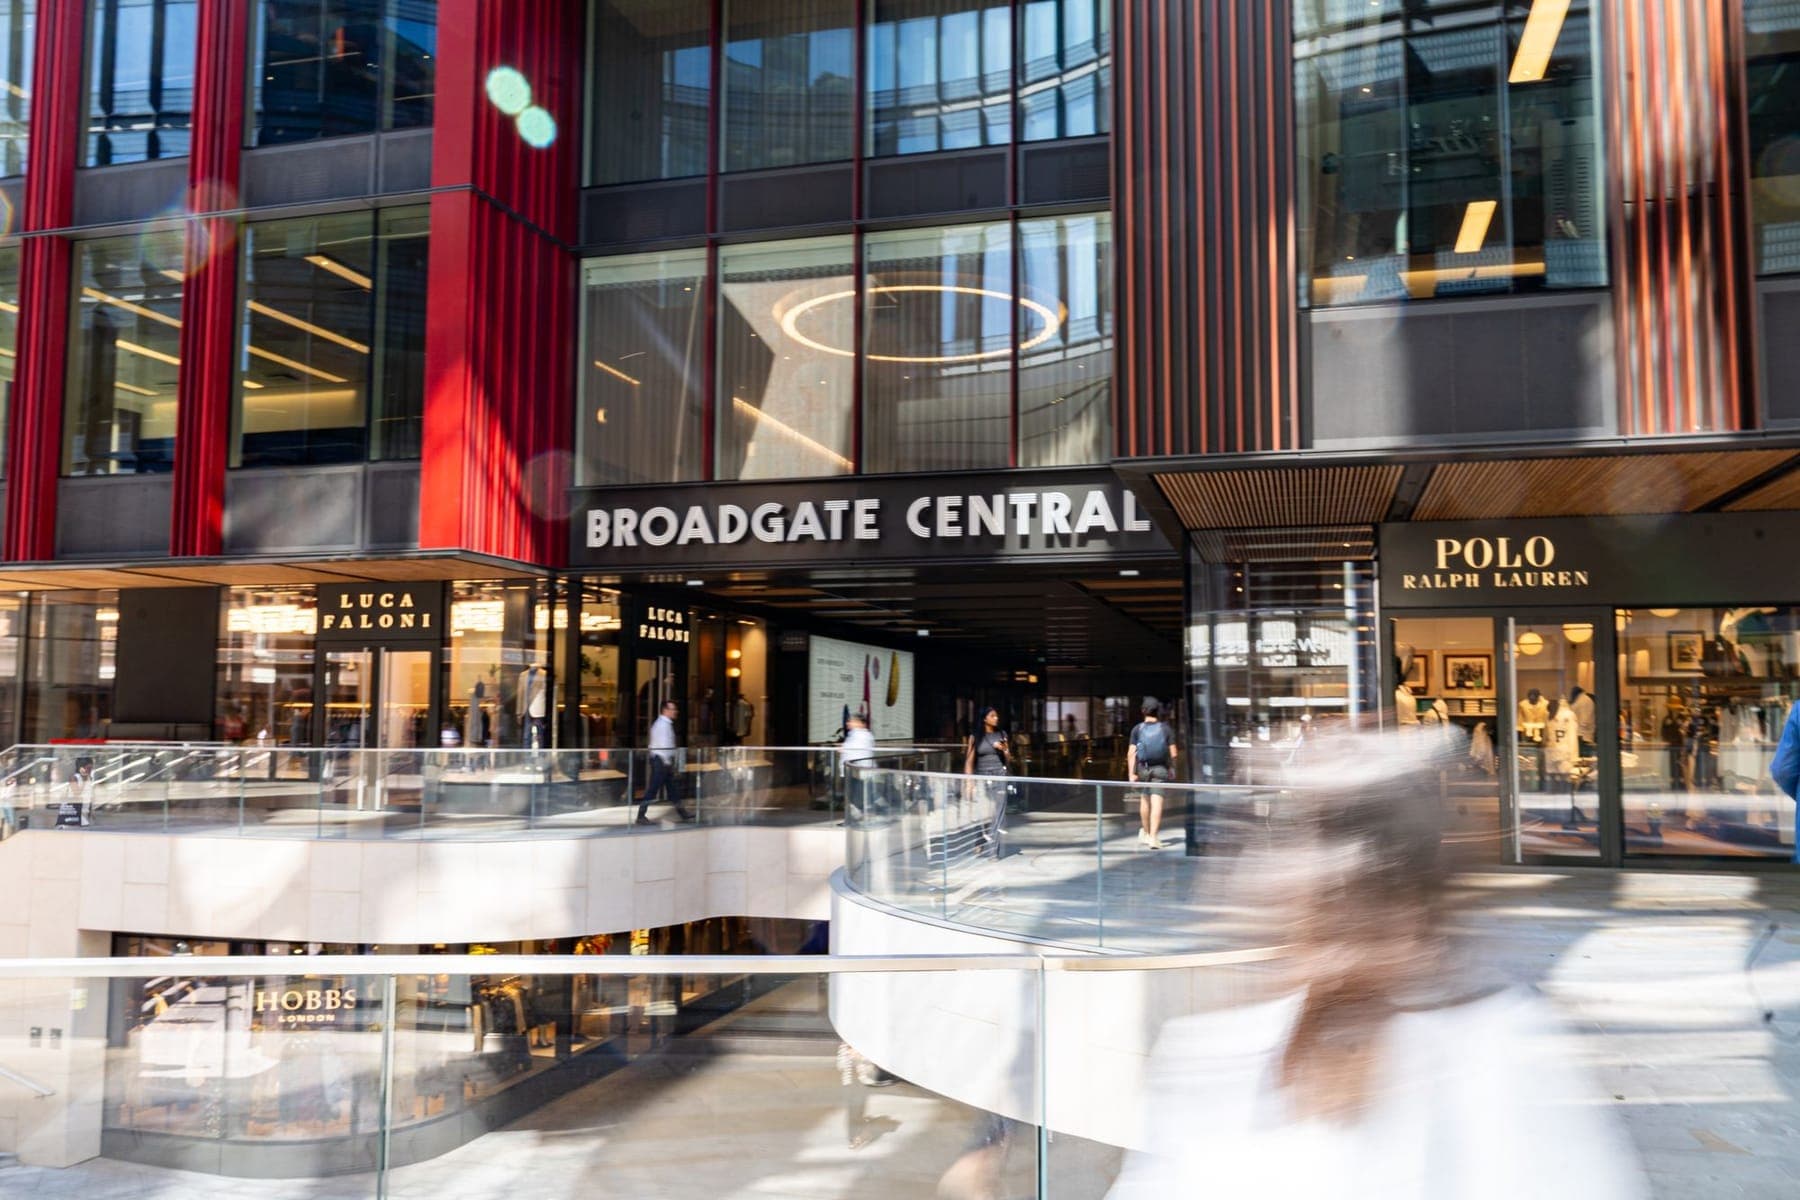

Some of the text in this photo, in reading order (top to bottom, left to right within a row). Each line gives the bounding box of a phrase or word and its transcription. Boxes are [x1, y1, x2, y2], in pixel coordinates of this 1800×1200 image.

[586, 490, 1151, 548] BROADGATE CENTRAL
[1434, 535, 1556, 570] POLO
[1402, 570, 1590, 589] RALPH LAUREN
[340, 592, 414, 609] LUCA
[322, 613, 431, 629] FALONI
[648, 606, 683, 625] LUCA
[639, 624, 690, 643] FALONI
[1555, 730, 1566, 742] P
[256, 988, 357, 1012] HOBBS
[278, 1014, 335, 1023] LONDON
